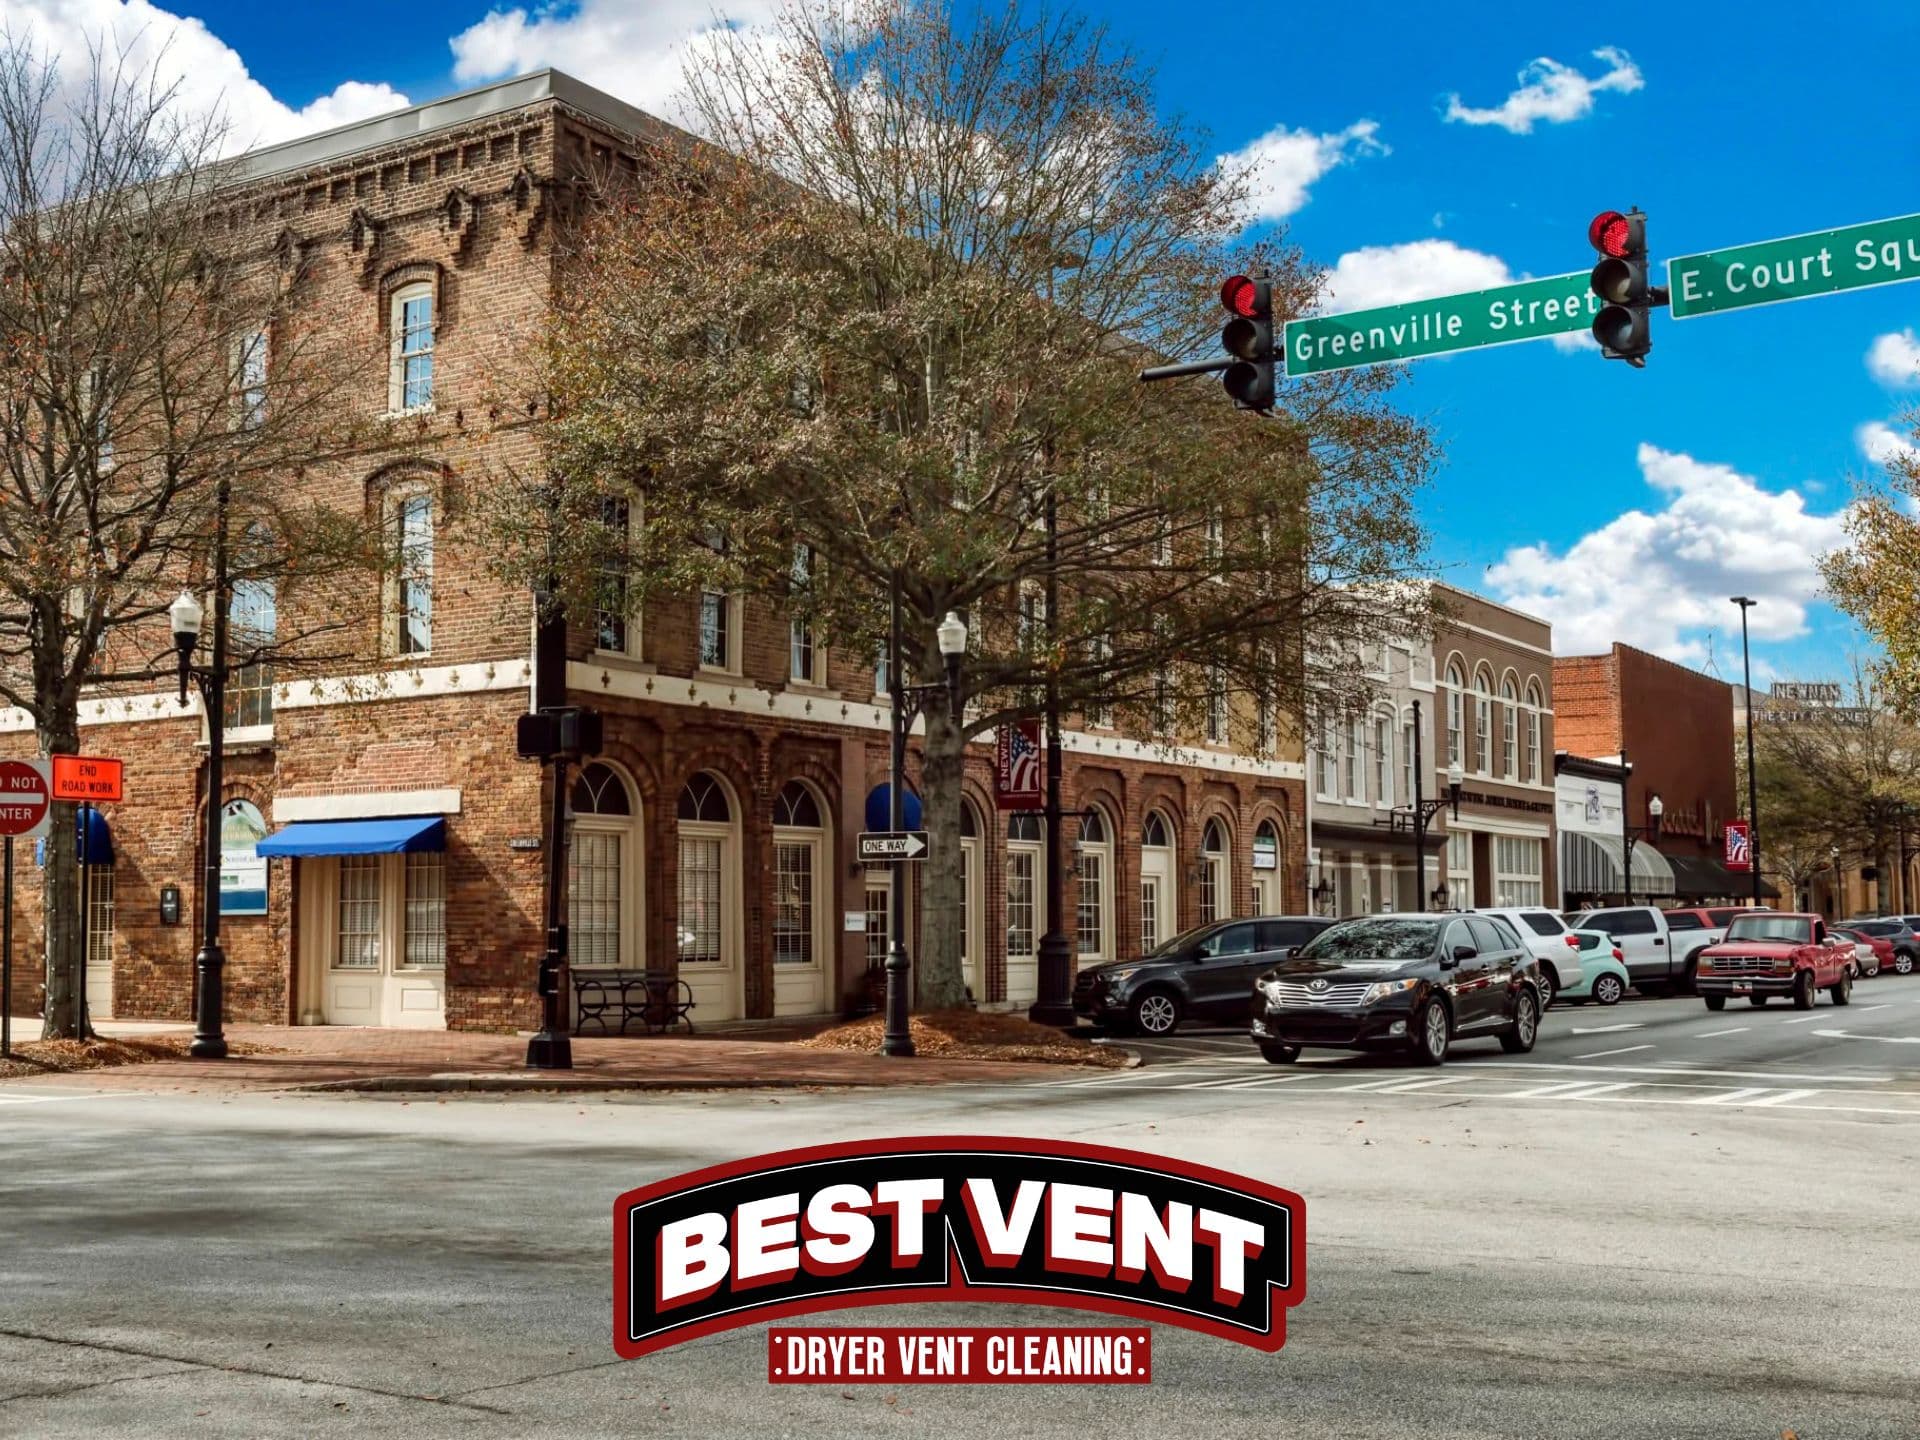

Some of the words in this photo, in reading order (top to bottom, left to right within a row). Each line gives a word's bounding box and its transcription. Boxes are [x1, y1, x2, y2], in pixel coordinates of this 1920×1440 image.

[1681, 270, 1713, 301] E.
[1726, 247, 1833, 293] Court
[1295, 311, 1463, 361] Greenville
[1489, 286, 1598, 330] Street
[79, 764, 97, 777] END
[11, 776, 39, 790] NOT
[61, 780, 86, 793] ROAD
[88, 782, 113, 794] WORK
[864, 841, 885, 852] ONE
[886, 839, 907, 851] WAY
